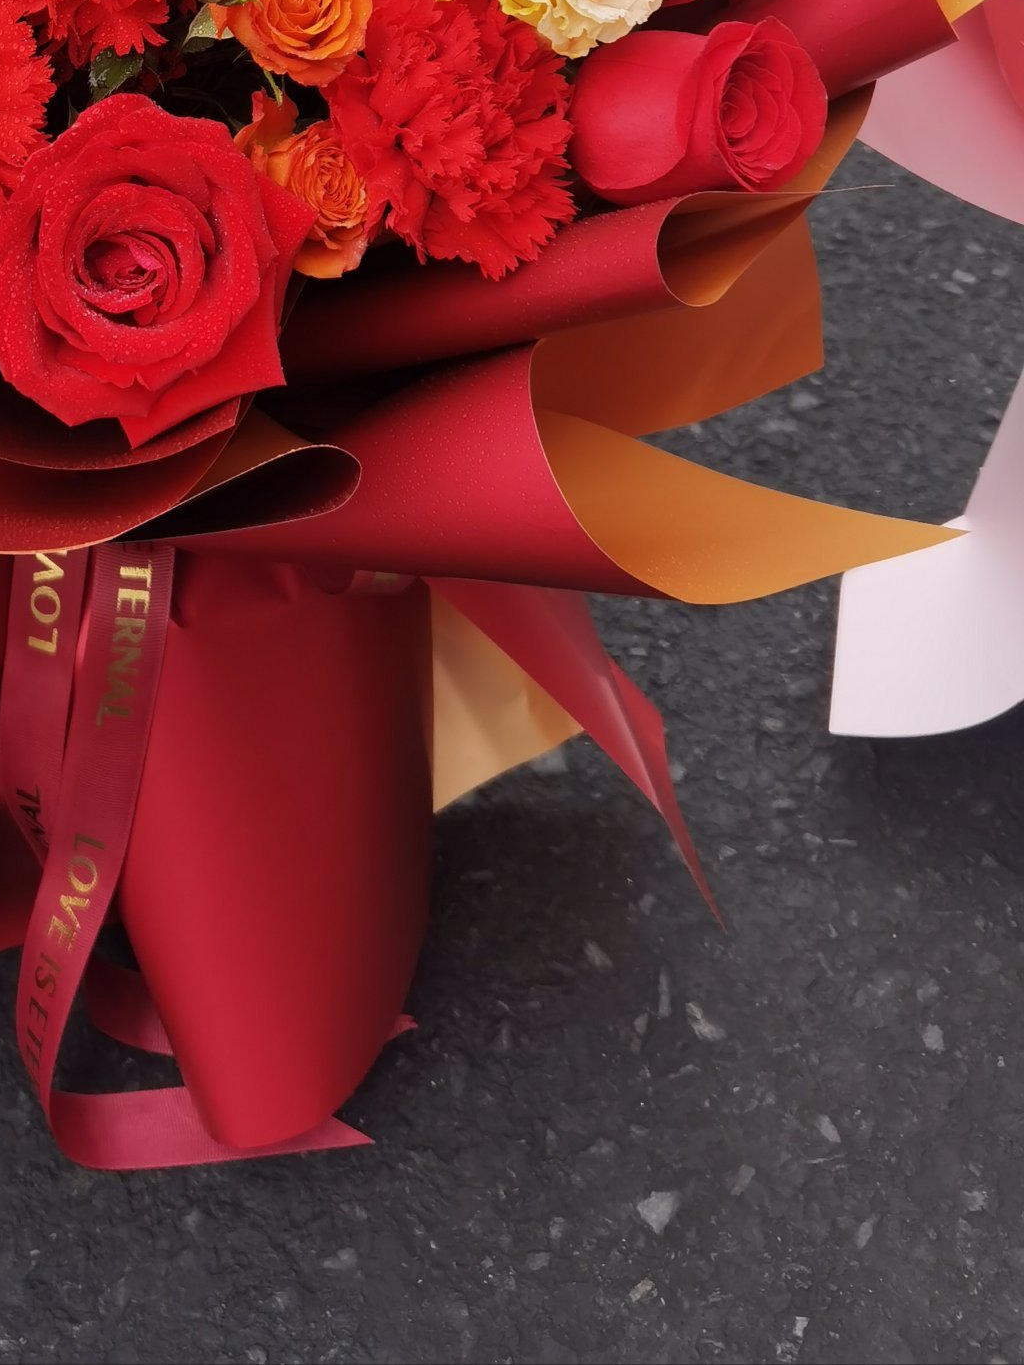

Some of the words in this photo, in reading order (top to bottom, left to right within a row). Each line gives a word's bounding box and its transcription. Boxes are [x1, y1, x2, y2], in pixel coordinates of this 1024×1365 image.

[28, 550, 68, 656] LOV
[48, 834, 107, 952] LOVE
[34, 952, 61, 998] IS
